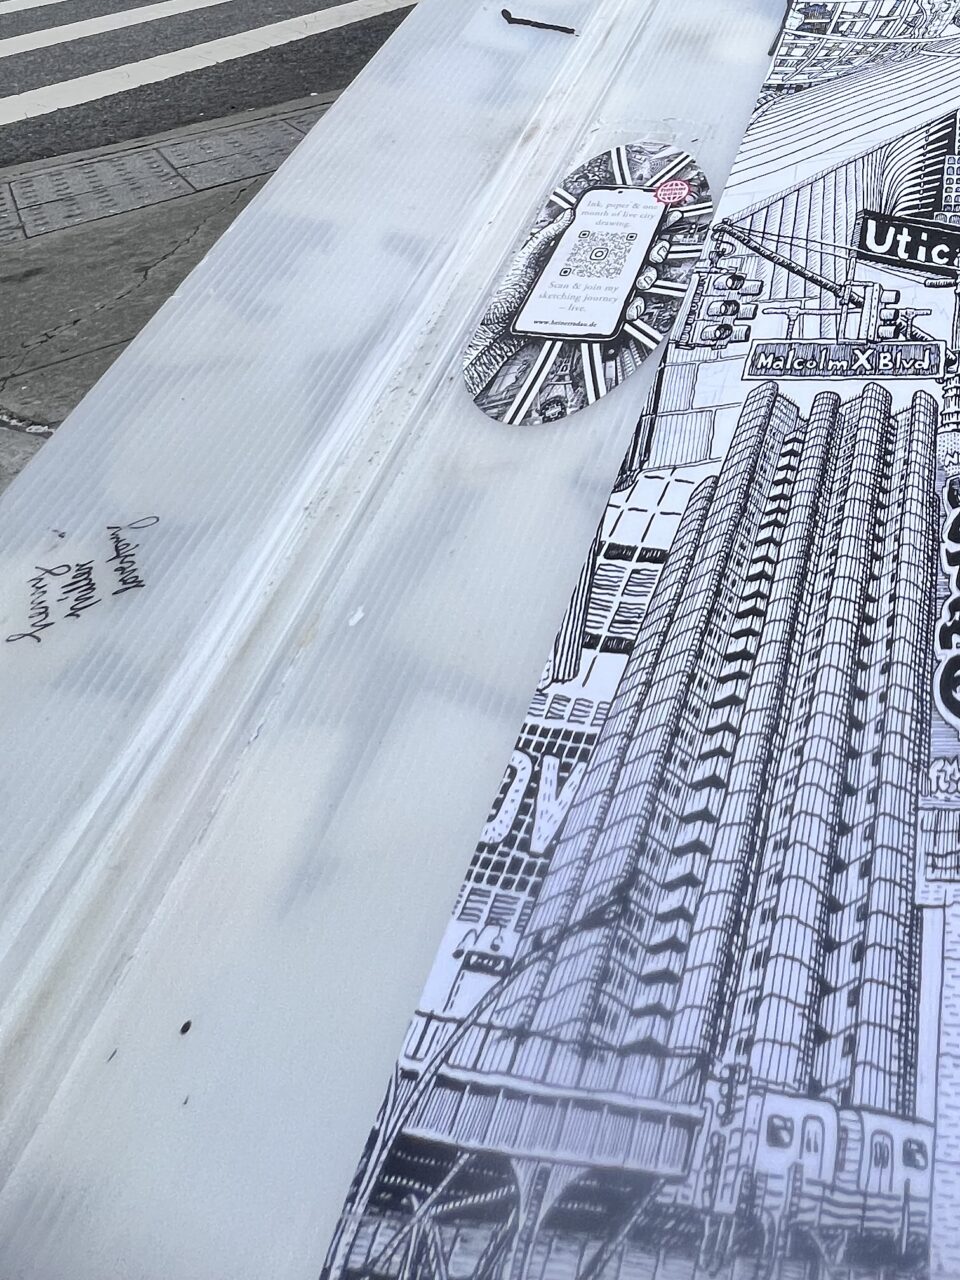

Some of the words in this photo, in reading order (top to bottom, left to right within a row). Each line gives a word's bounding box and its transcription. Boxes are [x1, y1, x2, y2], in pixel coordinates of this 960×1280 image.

[548, 281, 569, 289] Scan
[583, 282, 602, 292] join
[538, 291, 581, 303] sketching
[583, 293, 619, 304] journey
[756, 344, 849, 372] Malcolm
[851, 347, 874, 372] X
[879, 347, 931, 372] Blvd
